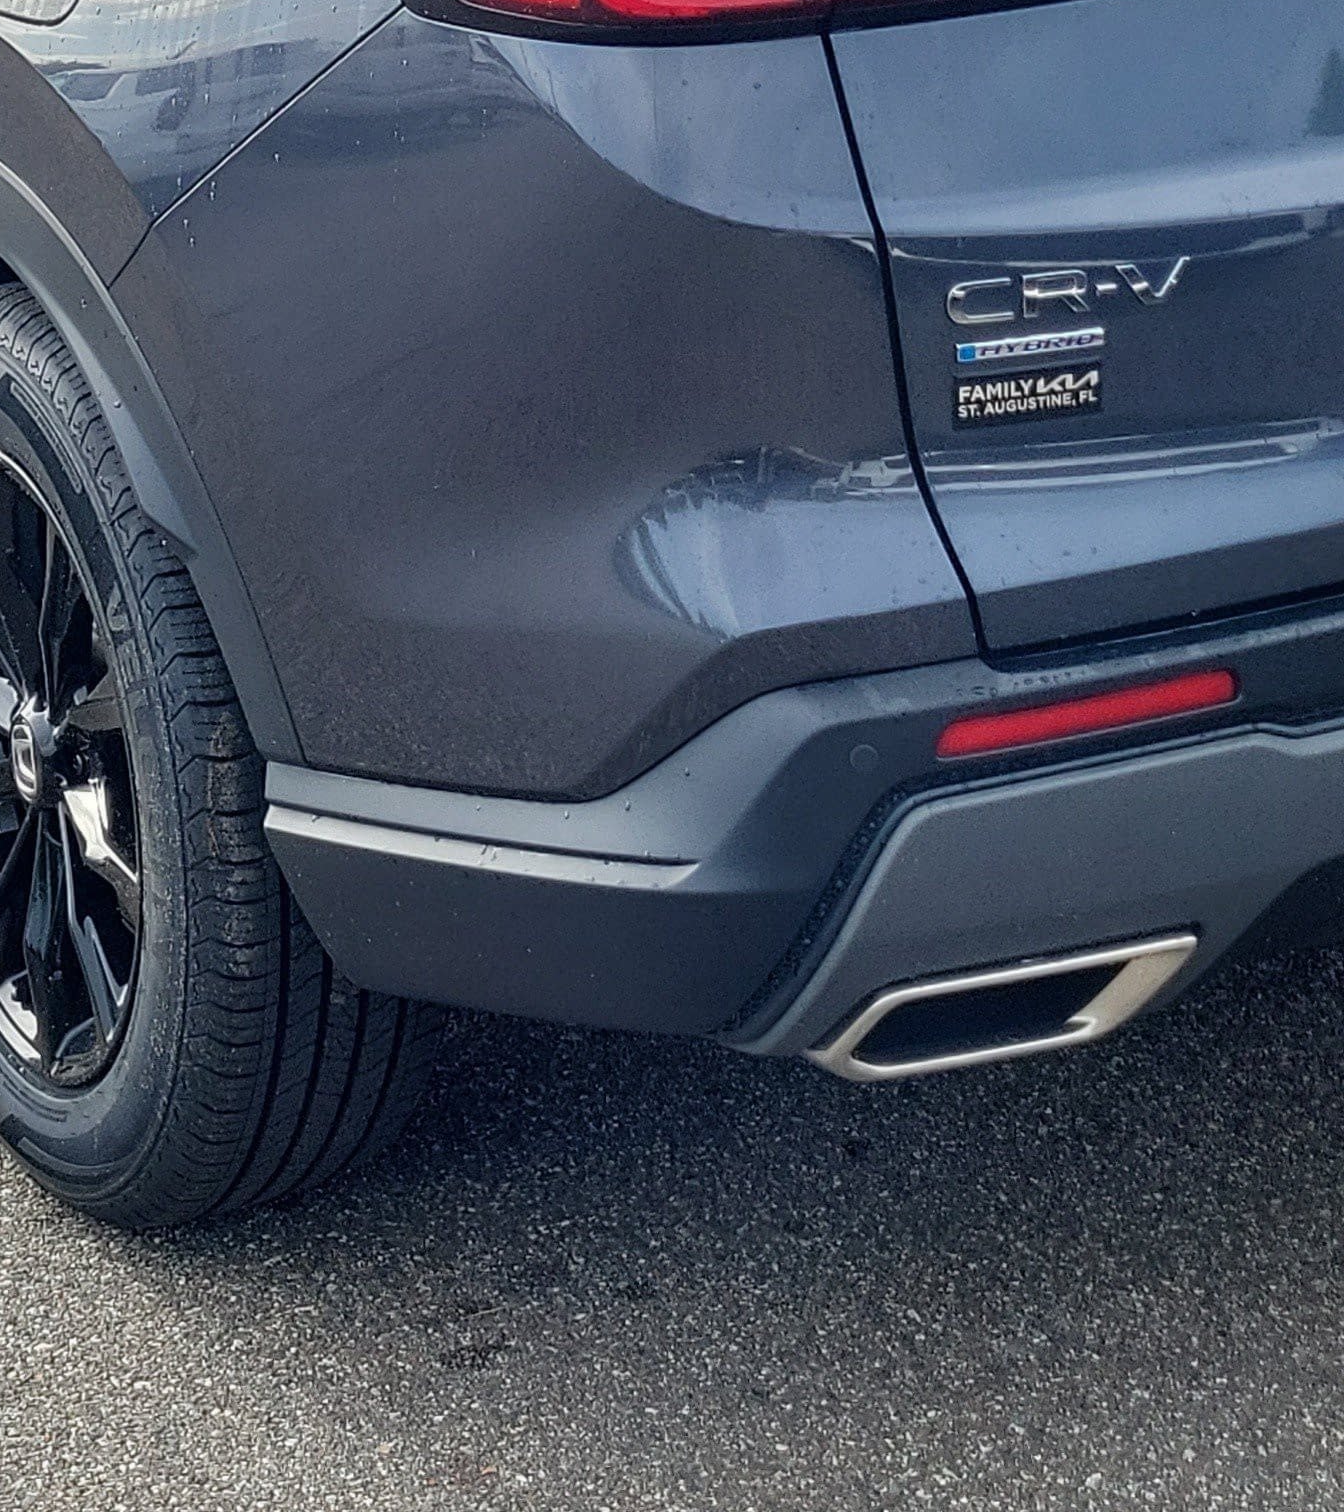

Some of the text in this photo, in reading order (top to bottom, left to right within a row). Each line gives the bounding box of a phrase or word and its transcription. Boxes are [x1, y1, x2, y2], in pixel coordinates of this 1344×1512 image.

[946, 256, 1190, 325] CR-V
[980, 334, 1095, 356] HYBRID
[958, 378, 1034, 404] FAMILY
[958, 389, 1098, 418] ST. AUGUSTINE, FL
